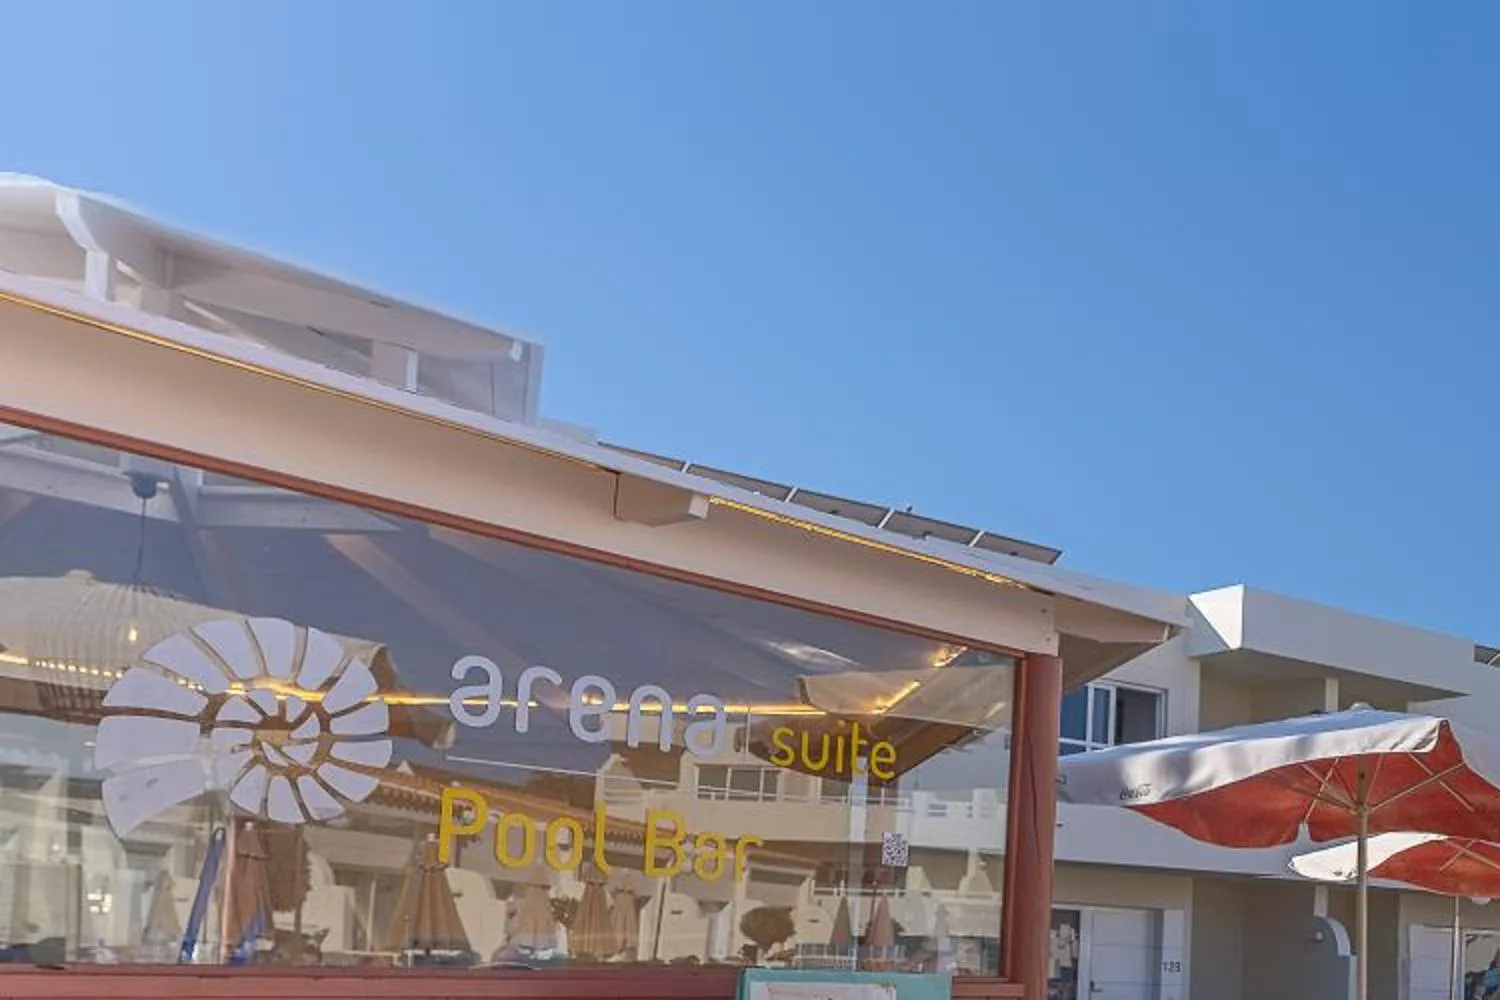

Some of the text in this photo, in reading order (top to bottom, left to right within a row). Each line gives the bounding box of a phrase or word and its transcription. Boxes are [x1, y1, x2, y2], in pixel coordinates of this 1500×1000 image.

[448, 654, 897, 780] arena suite
[438, 787, 763, 881] Pool Bar
